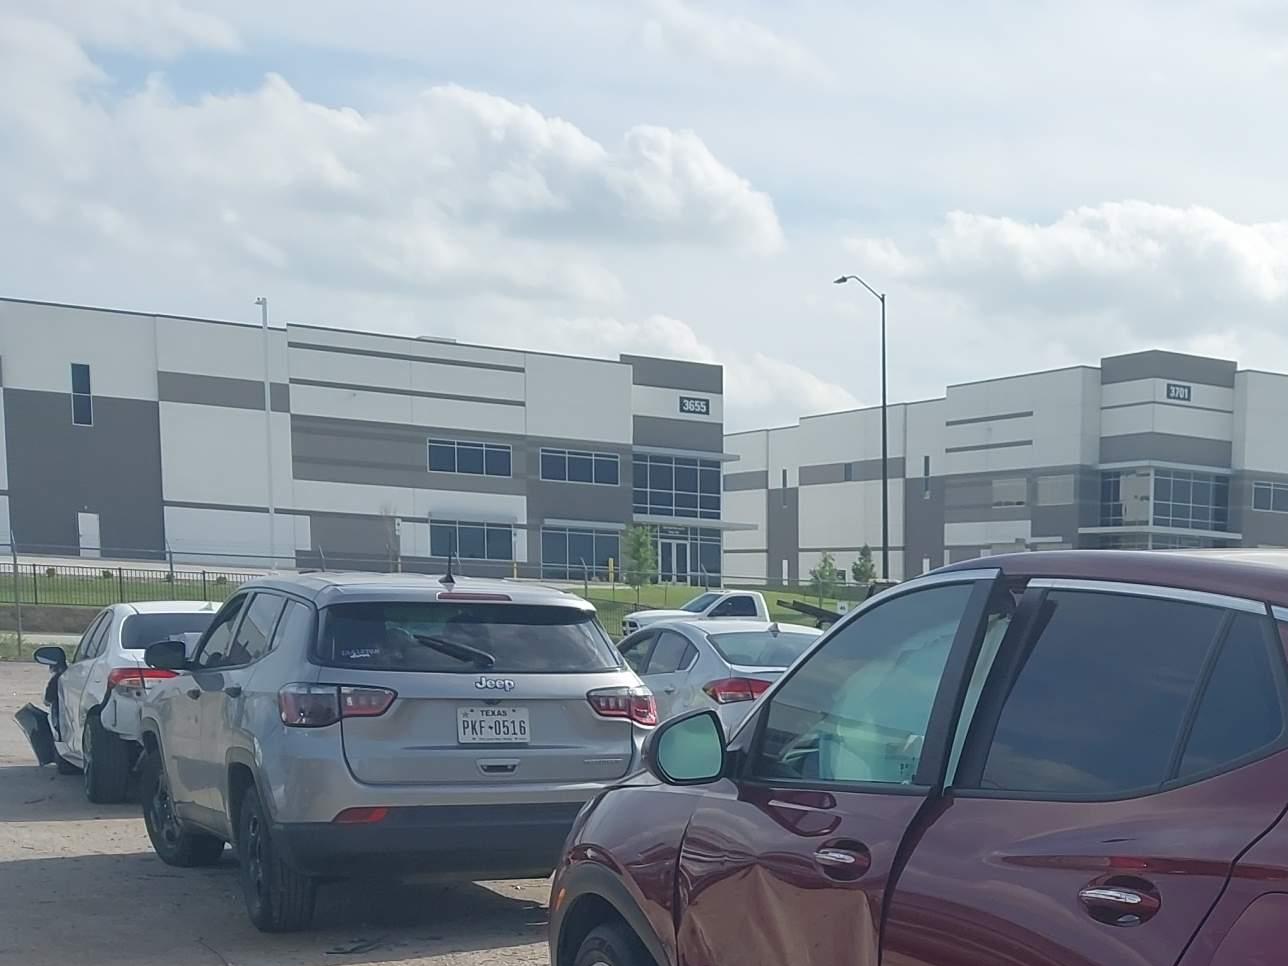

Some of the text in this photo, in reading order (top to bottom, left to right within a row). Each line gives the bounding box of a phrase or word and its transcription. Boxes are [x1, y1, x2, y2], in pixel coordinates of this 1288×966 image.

[1169, 386, 1189, 399] 3701
[682, 399, 706, 413] 3655
[474, 676, 515, 691] Jeep
[480, 709, 508, 717] TEXAS
